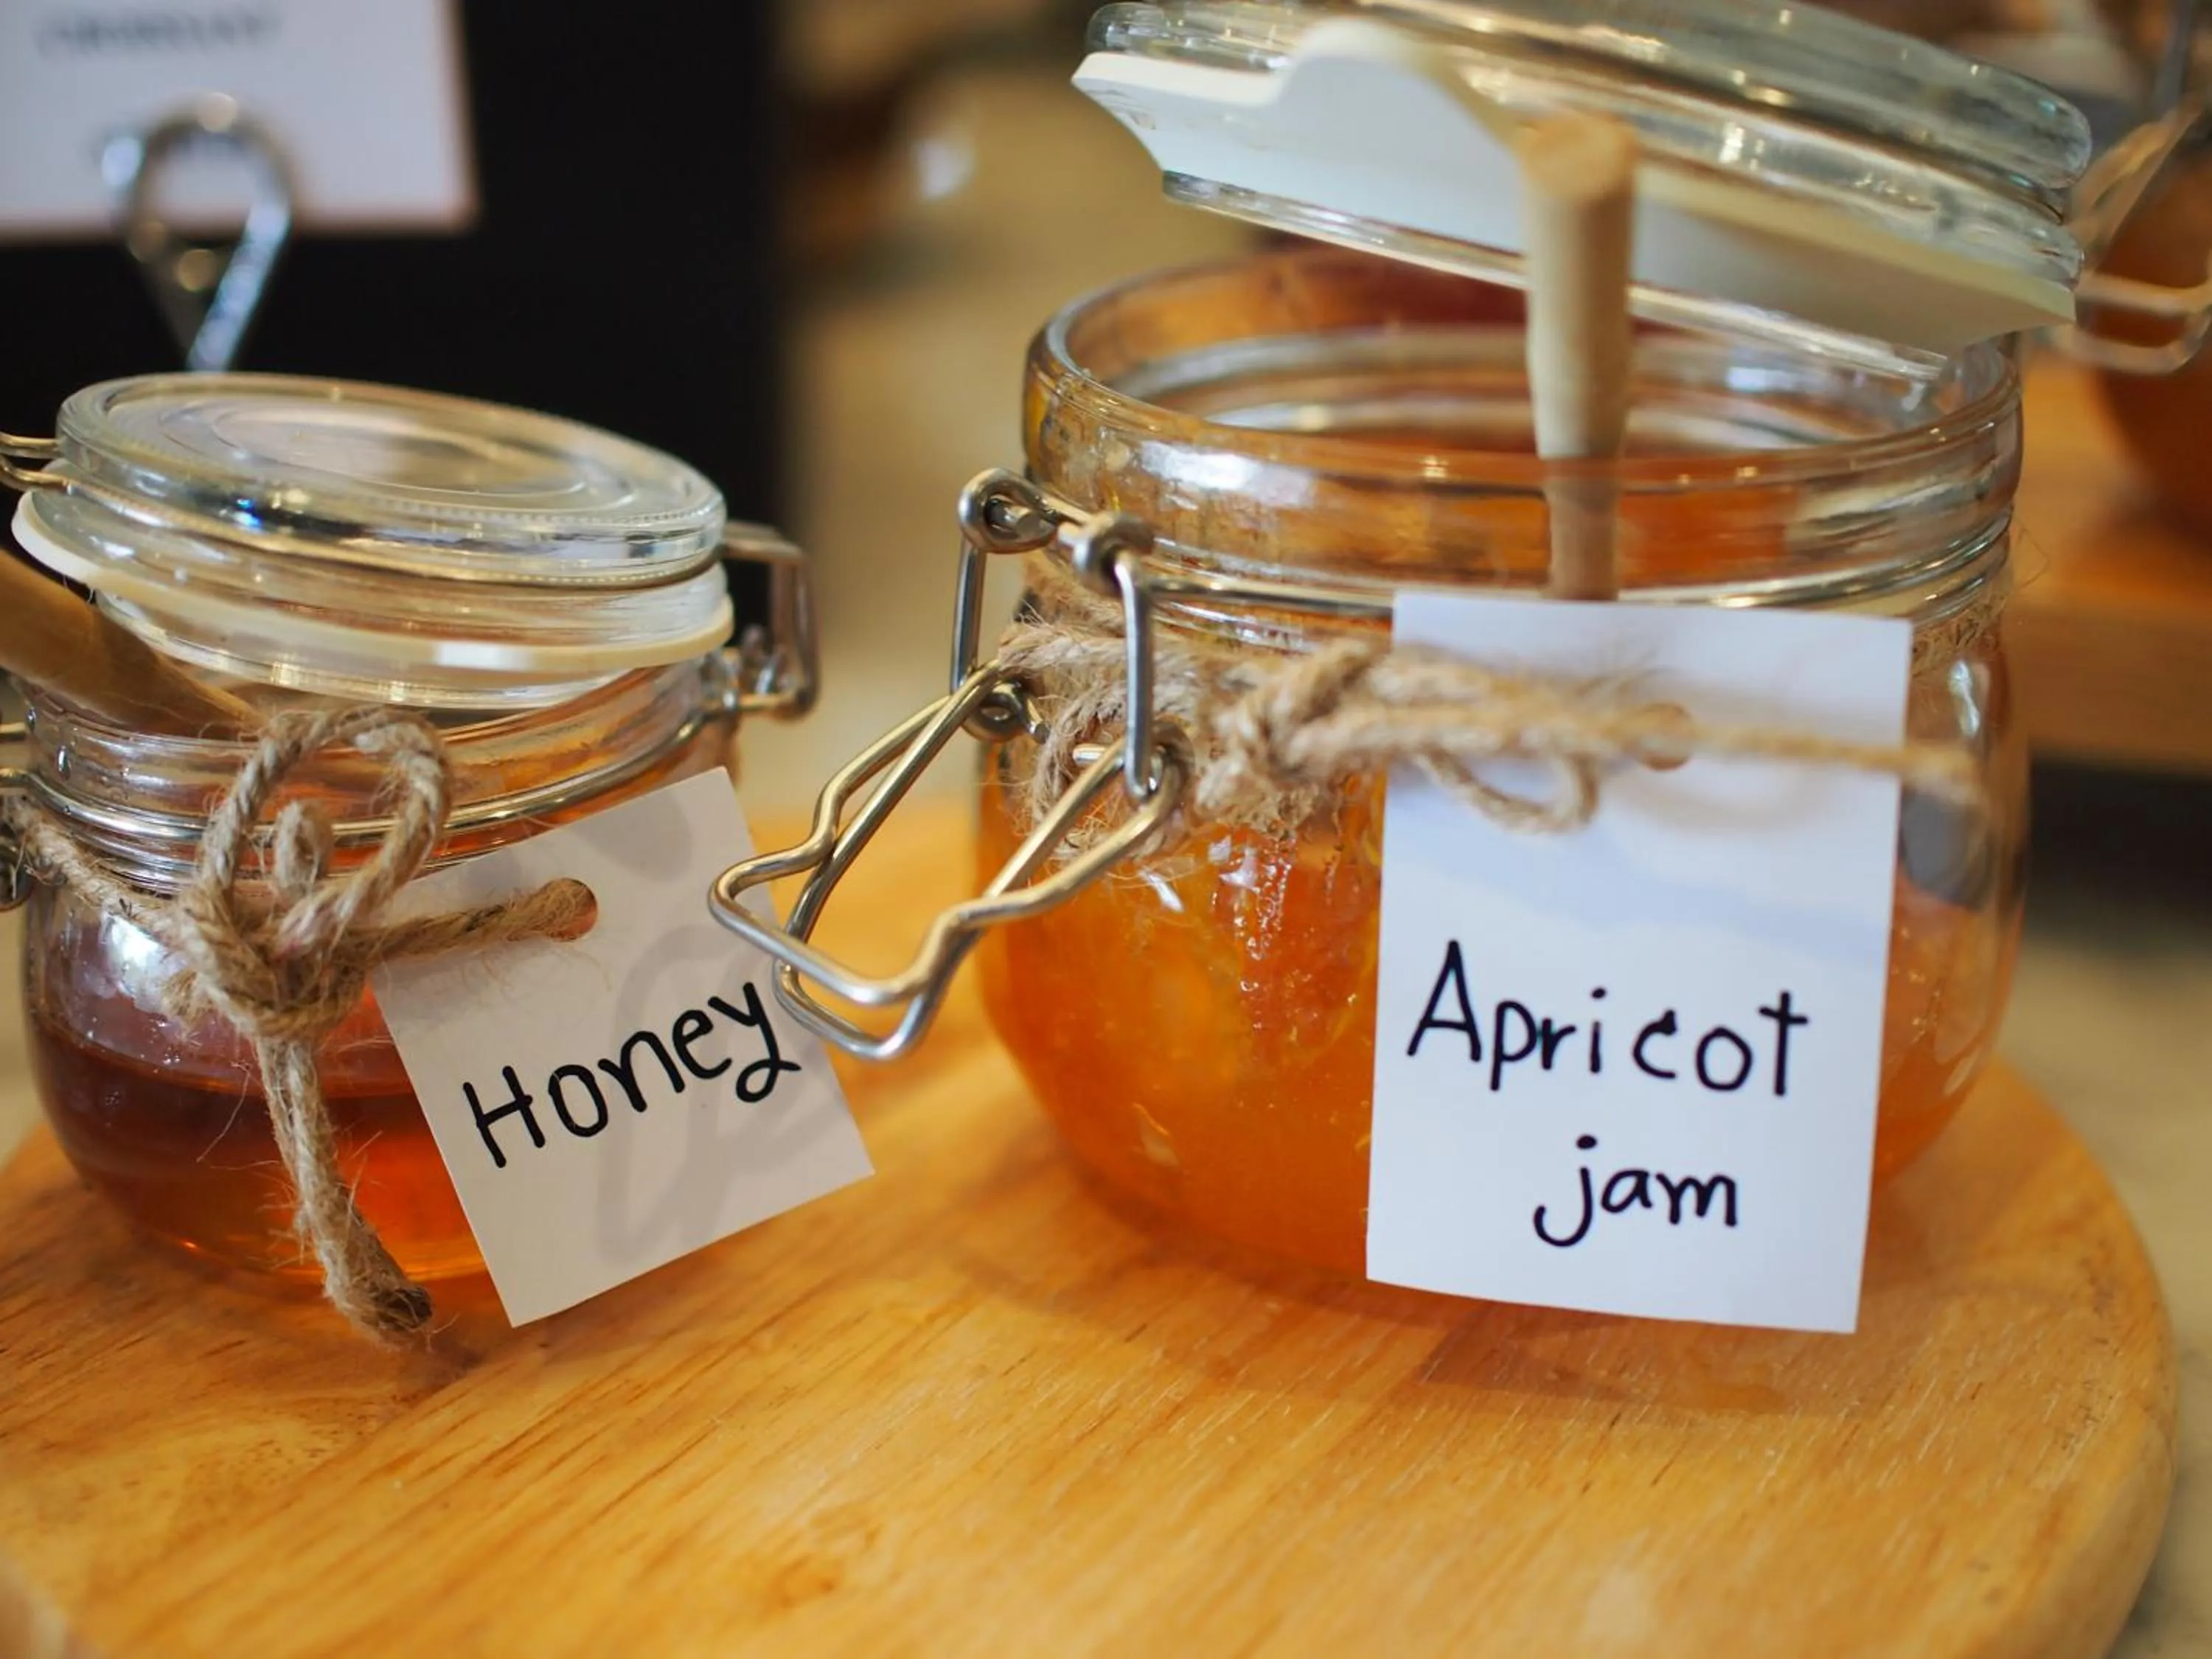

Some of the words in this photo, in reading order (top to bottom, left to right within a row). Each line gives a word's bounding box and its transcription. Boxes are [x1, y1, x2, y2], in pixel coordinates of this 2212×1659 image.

[462, 981, 802, 1169] Honey
[1406, 939, 1809, 1097] Apricot
[1533, 1134, 1738, 1248] jam
